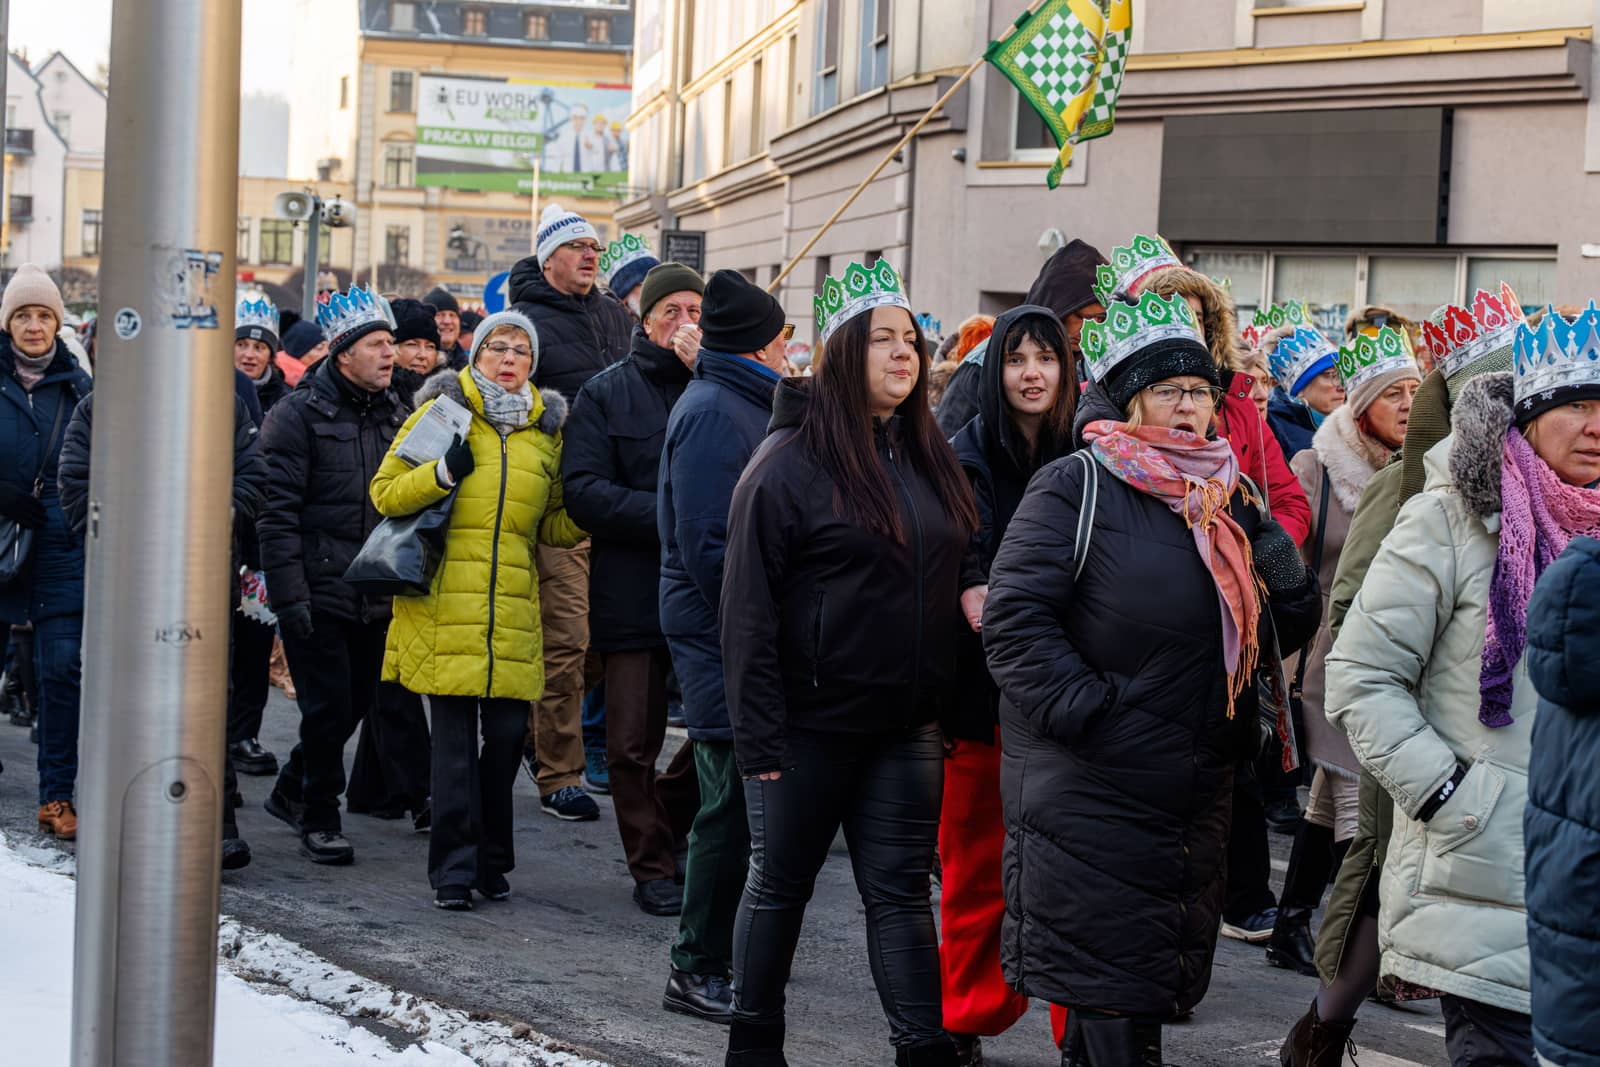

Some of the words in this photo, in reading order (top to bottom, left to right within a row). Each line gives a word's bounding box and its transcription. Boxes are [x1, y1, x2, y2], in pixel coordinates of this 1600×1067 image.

[456, 89, 480, 106] EU
[484, 92, 537, 110] WORK
[422, 129, 472, 145] PRACA
[473, 132, 491, 146] W
[154, 628, 203, 642] ROSA
